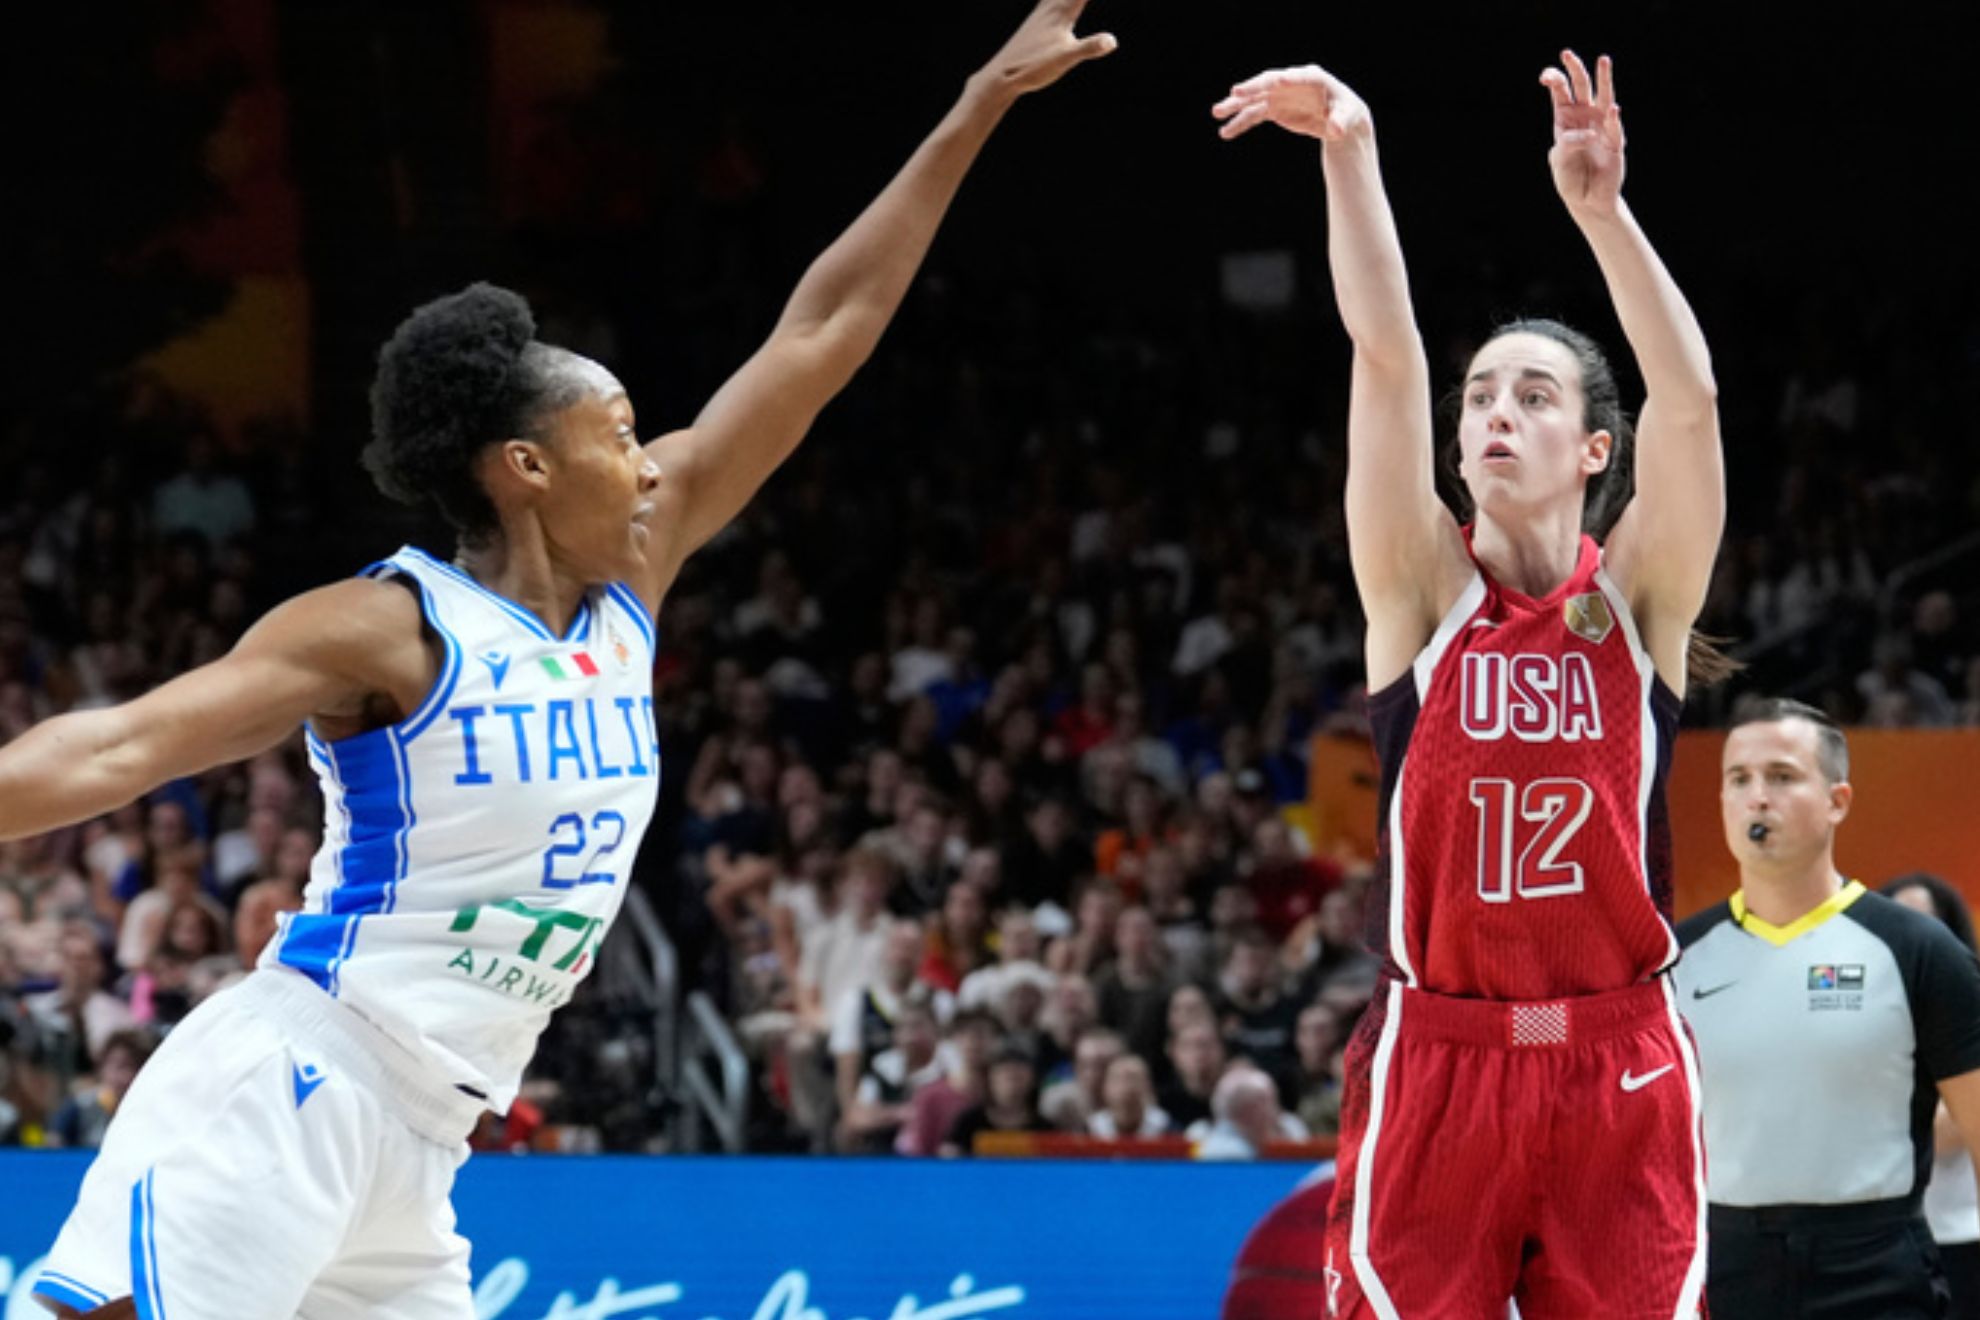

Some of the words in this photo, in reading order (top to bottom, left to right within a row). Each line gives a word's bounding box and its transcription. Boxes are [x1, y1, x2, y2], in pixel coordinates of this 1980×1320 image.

[1460, 652, 1603, 741] USA
[541, 810, 626, 889] 22
[1470, 778, 1594, 903] 12
